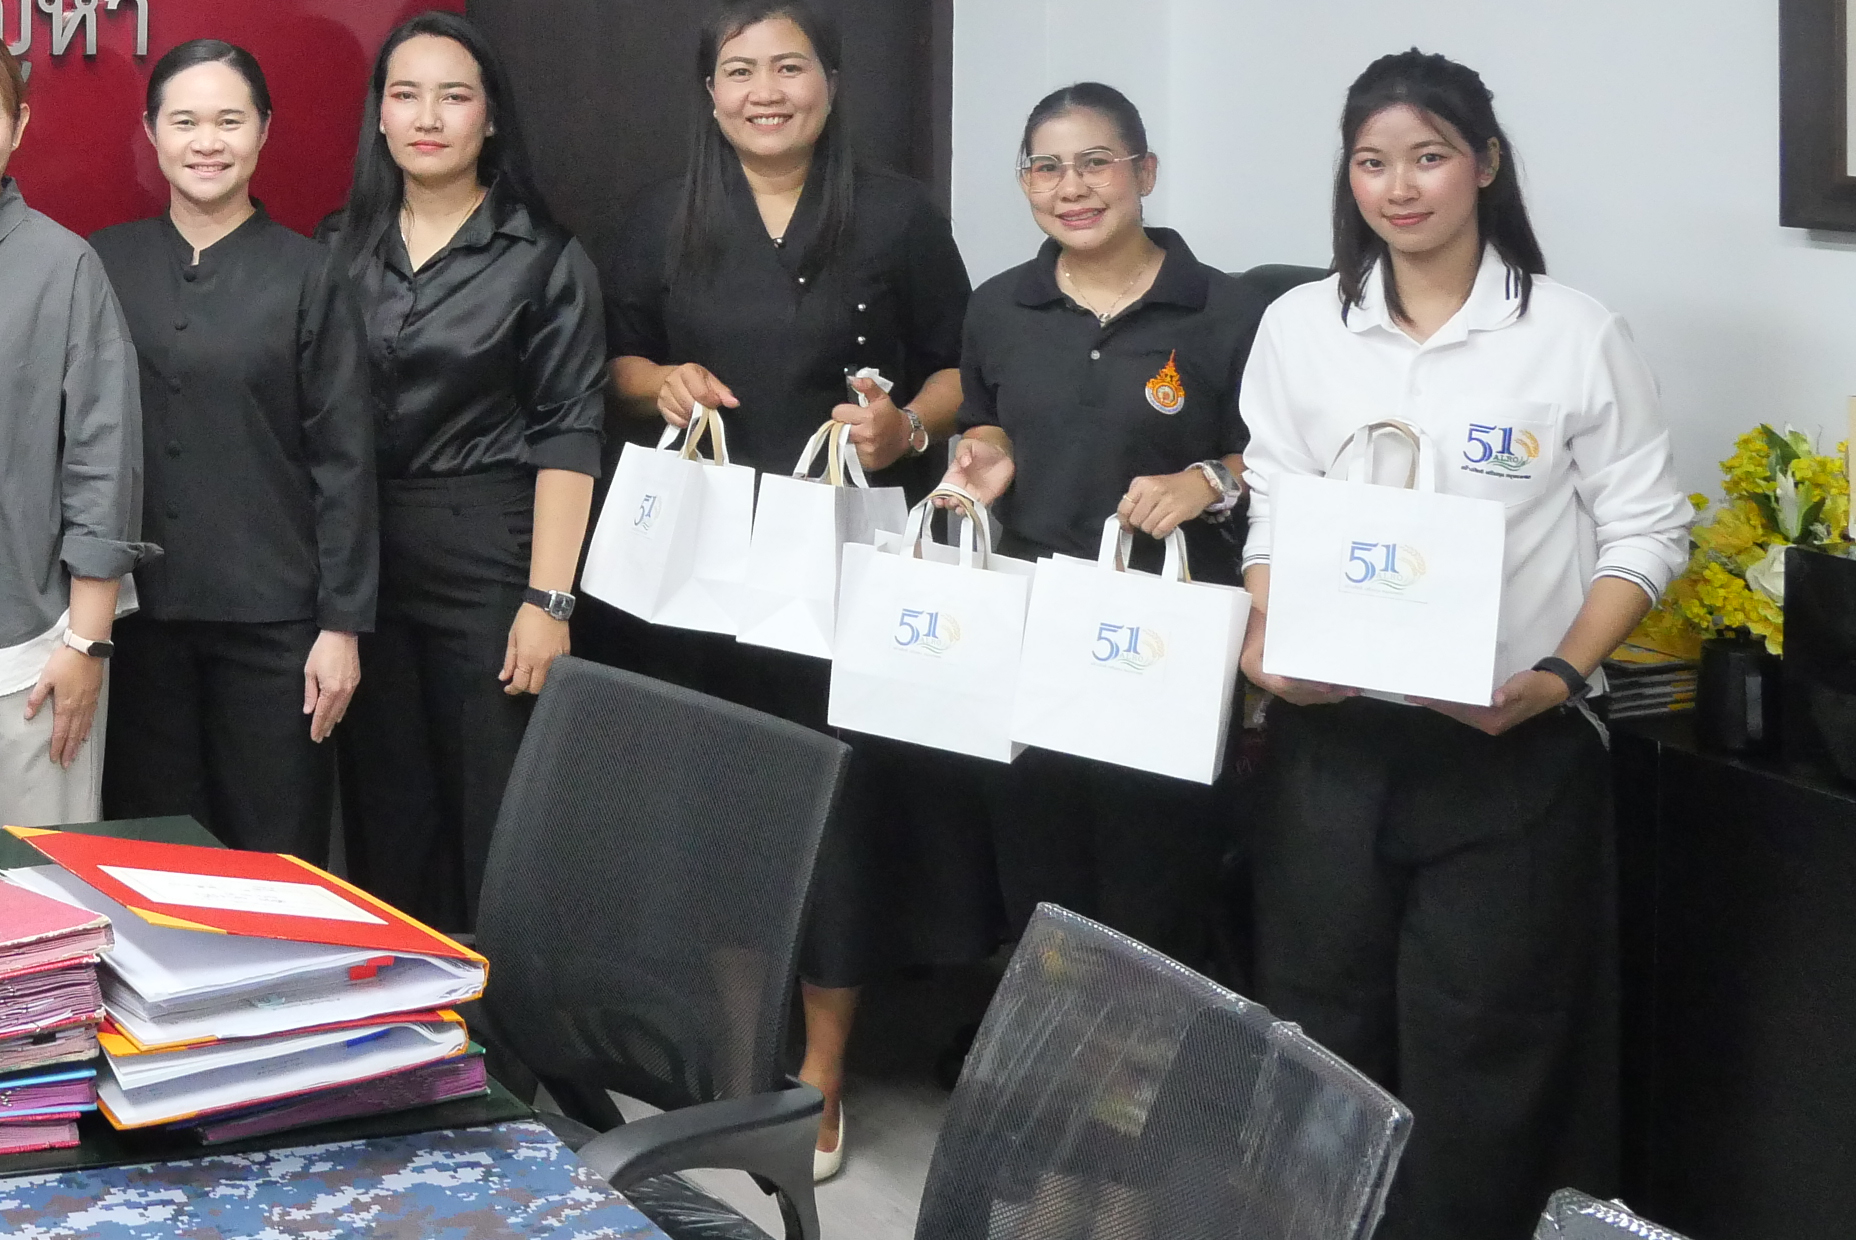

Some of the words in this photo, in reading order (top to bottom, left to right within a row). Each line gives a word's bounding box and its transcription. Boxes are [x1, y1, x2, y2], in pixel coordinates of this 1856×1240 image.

[1463, 423, 1515, 463] 51
[1493, 454, 1519, 463] ALRO
[1344, 541, 1400, 584] 51
[894, 608, 939, 646] 51
[1092, 622, 1141, 662] 51
